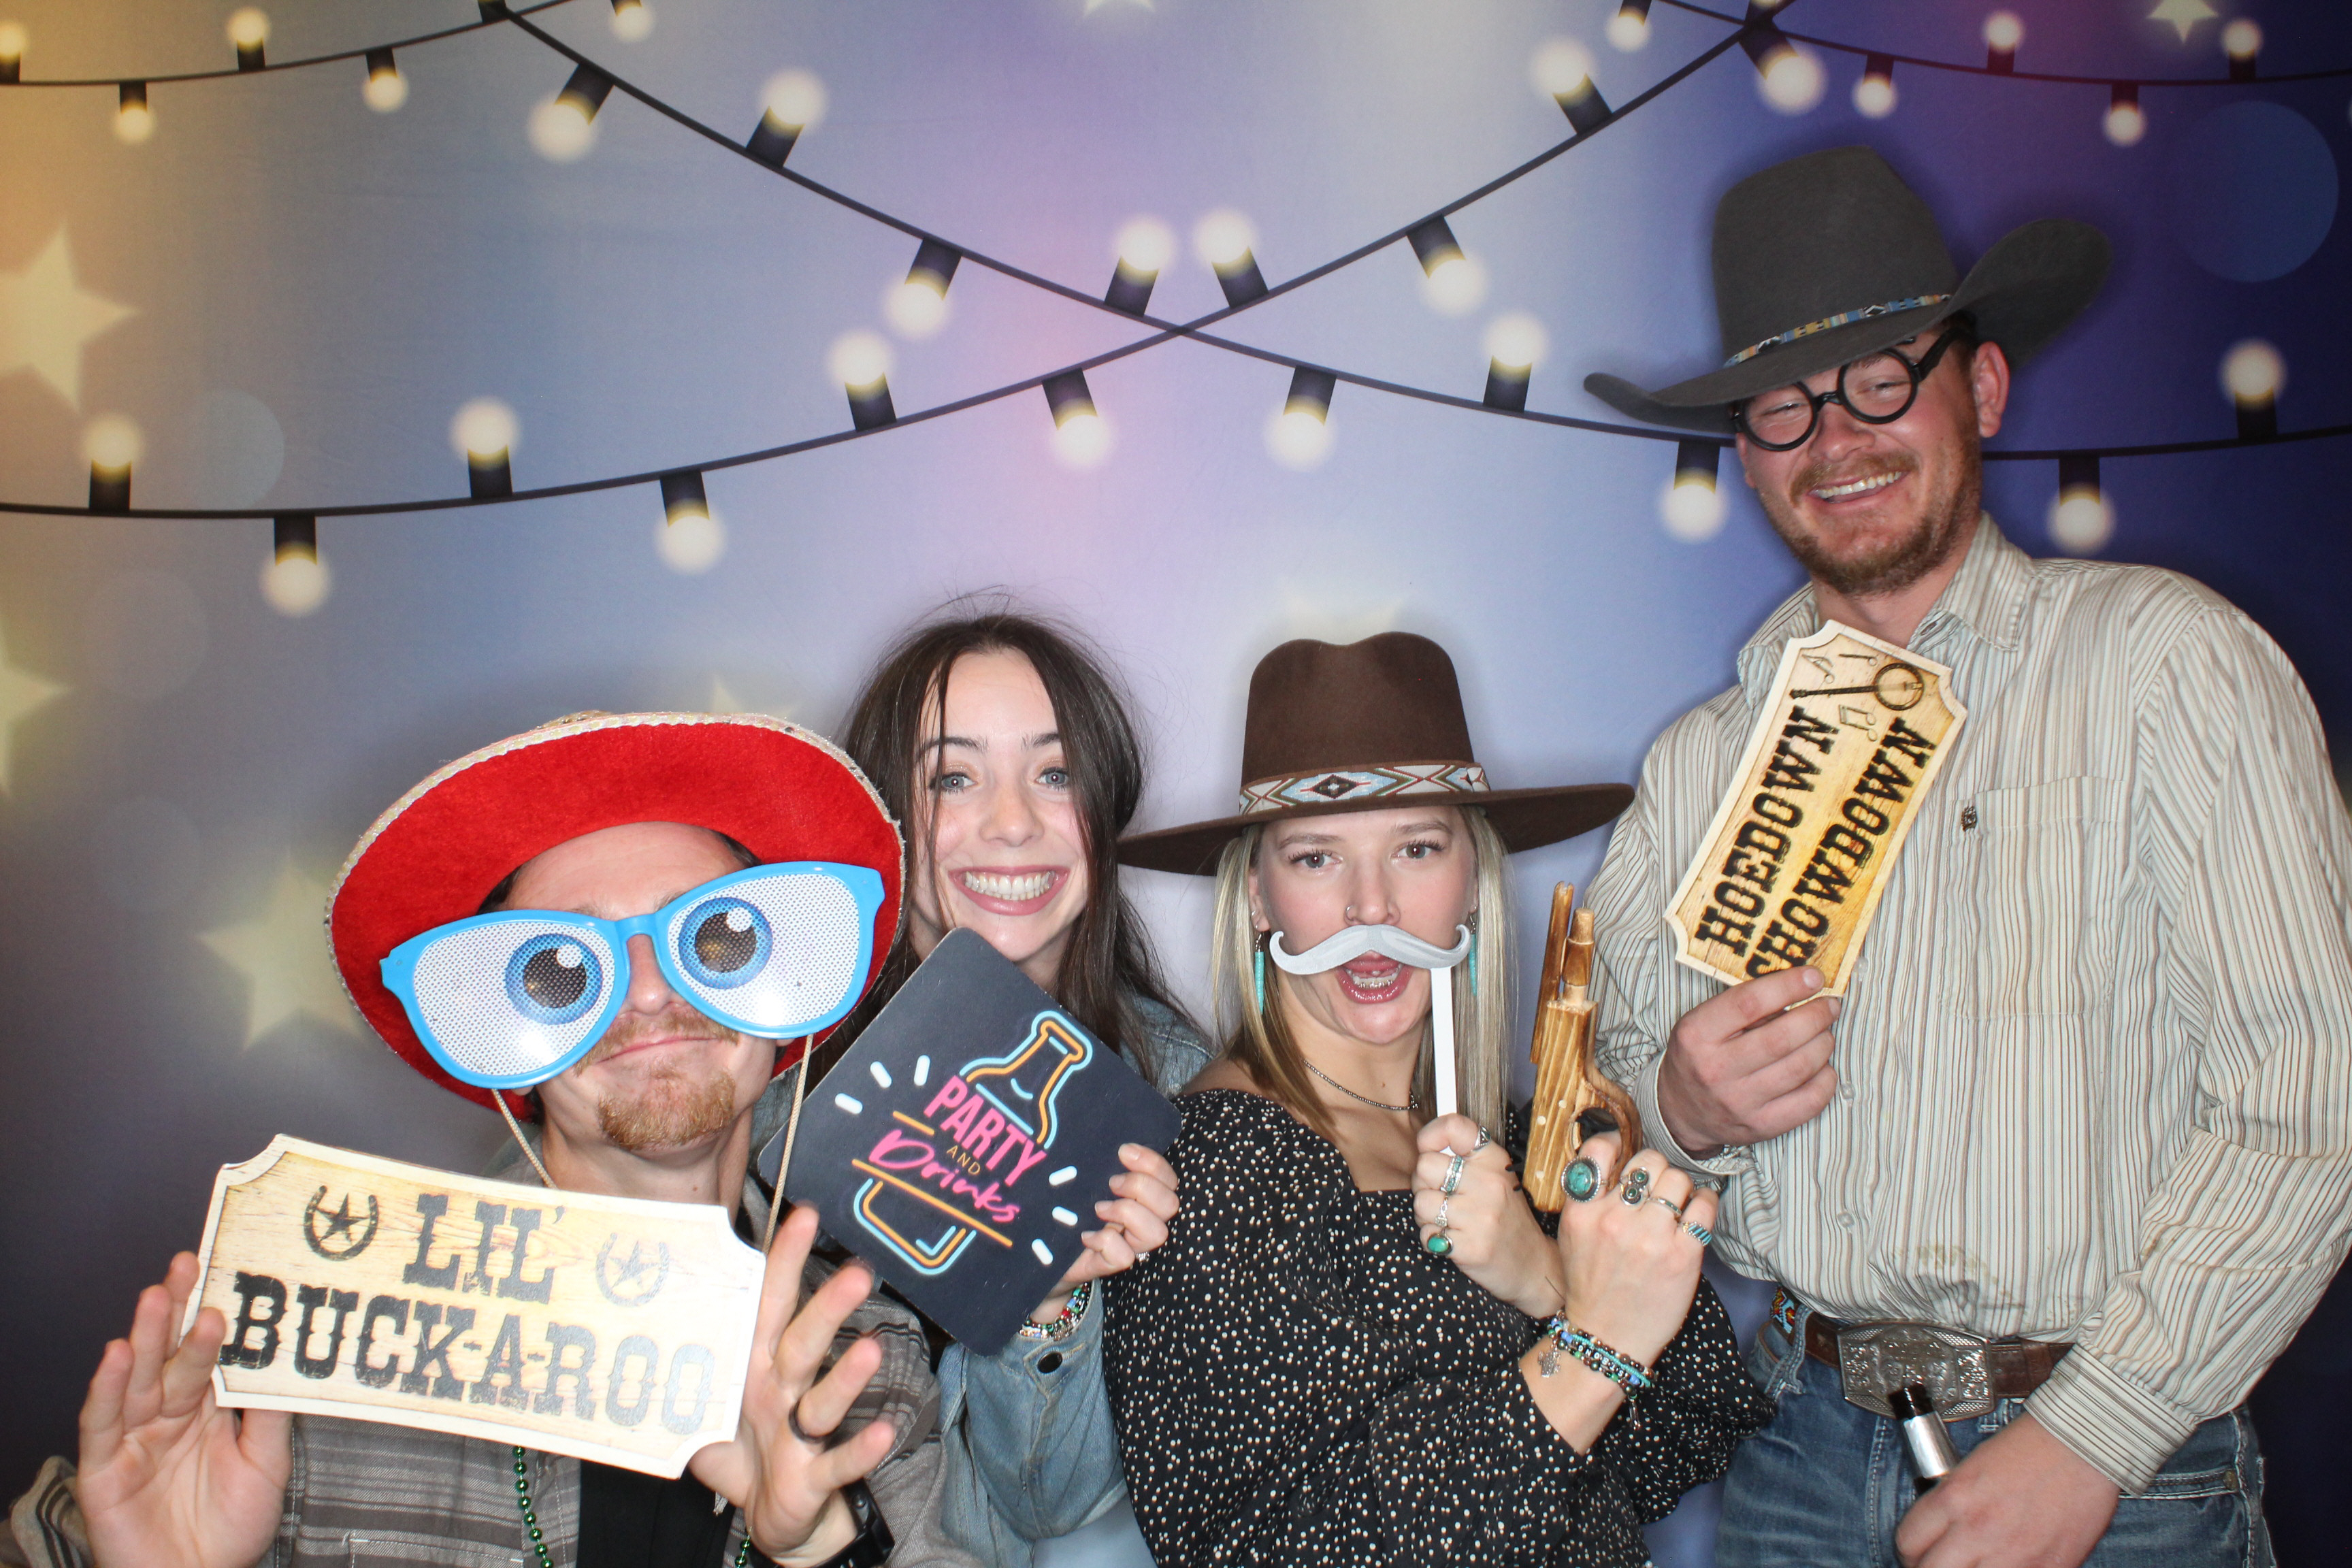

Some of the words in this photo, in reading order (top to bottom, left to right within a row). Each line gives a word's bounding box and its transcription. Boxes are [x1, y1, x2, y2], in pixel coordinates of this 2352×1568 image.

[1695, 705, 1840, 958] HOEDOWN
[868, 1129, 1020, 1223] Drinks
[924, 1075, 1047, 1188] PARTY
[946, 1145, 982, 1175] AND
[402, 1192, 566, 1305] LIL'
[218, 1271, 716, 1435] BUCK-A-ROO
[1577, 1343, 1626, 1377] STRONG
